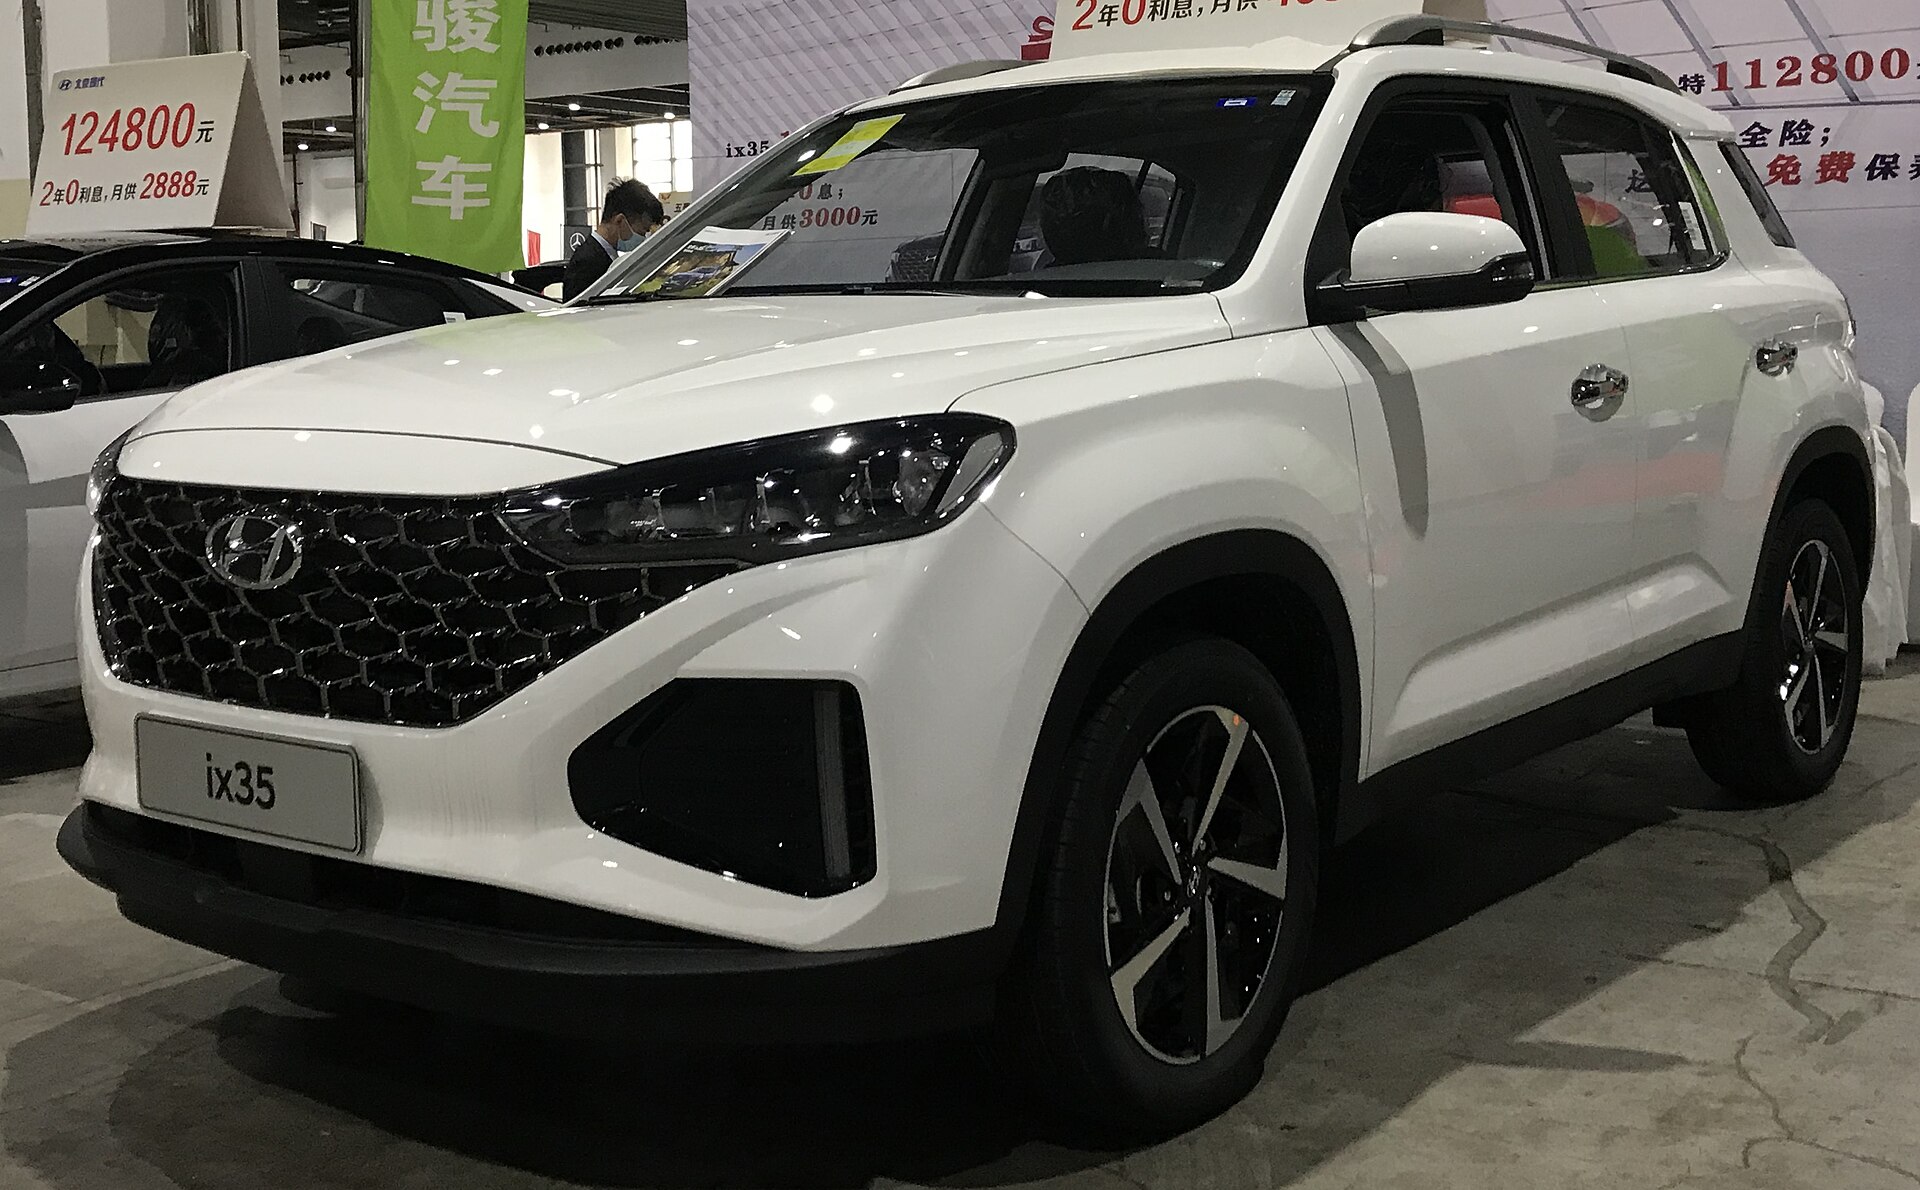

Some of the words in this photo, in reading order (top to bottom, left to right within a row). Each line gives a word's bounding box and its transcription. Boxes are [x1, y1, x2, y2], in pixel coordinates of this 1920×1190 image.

[1678, 47, 1920, 95] 特112800
[60, 102, 215, 156] 124800元
[411, 0, 502, 220] 骏汽车
[725, 140, 770, 158] ix35
[761, 205, 879, 231] 月供3000元
[206, 752, 276, 810] ix35
